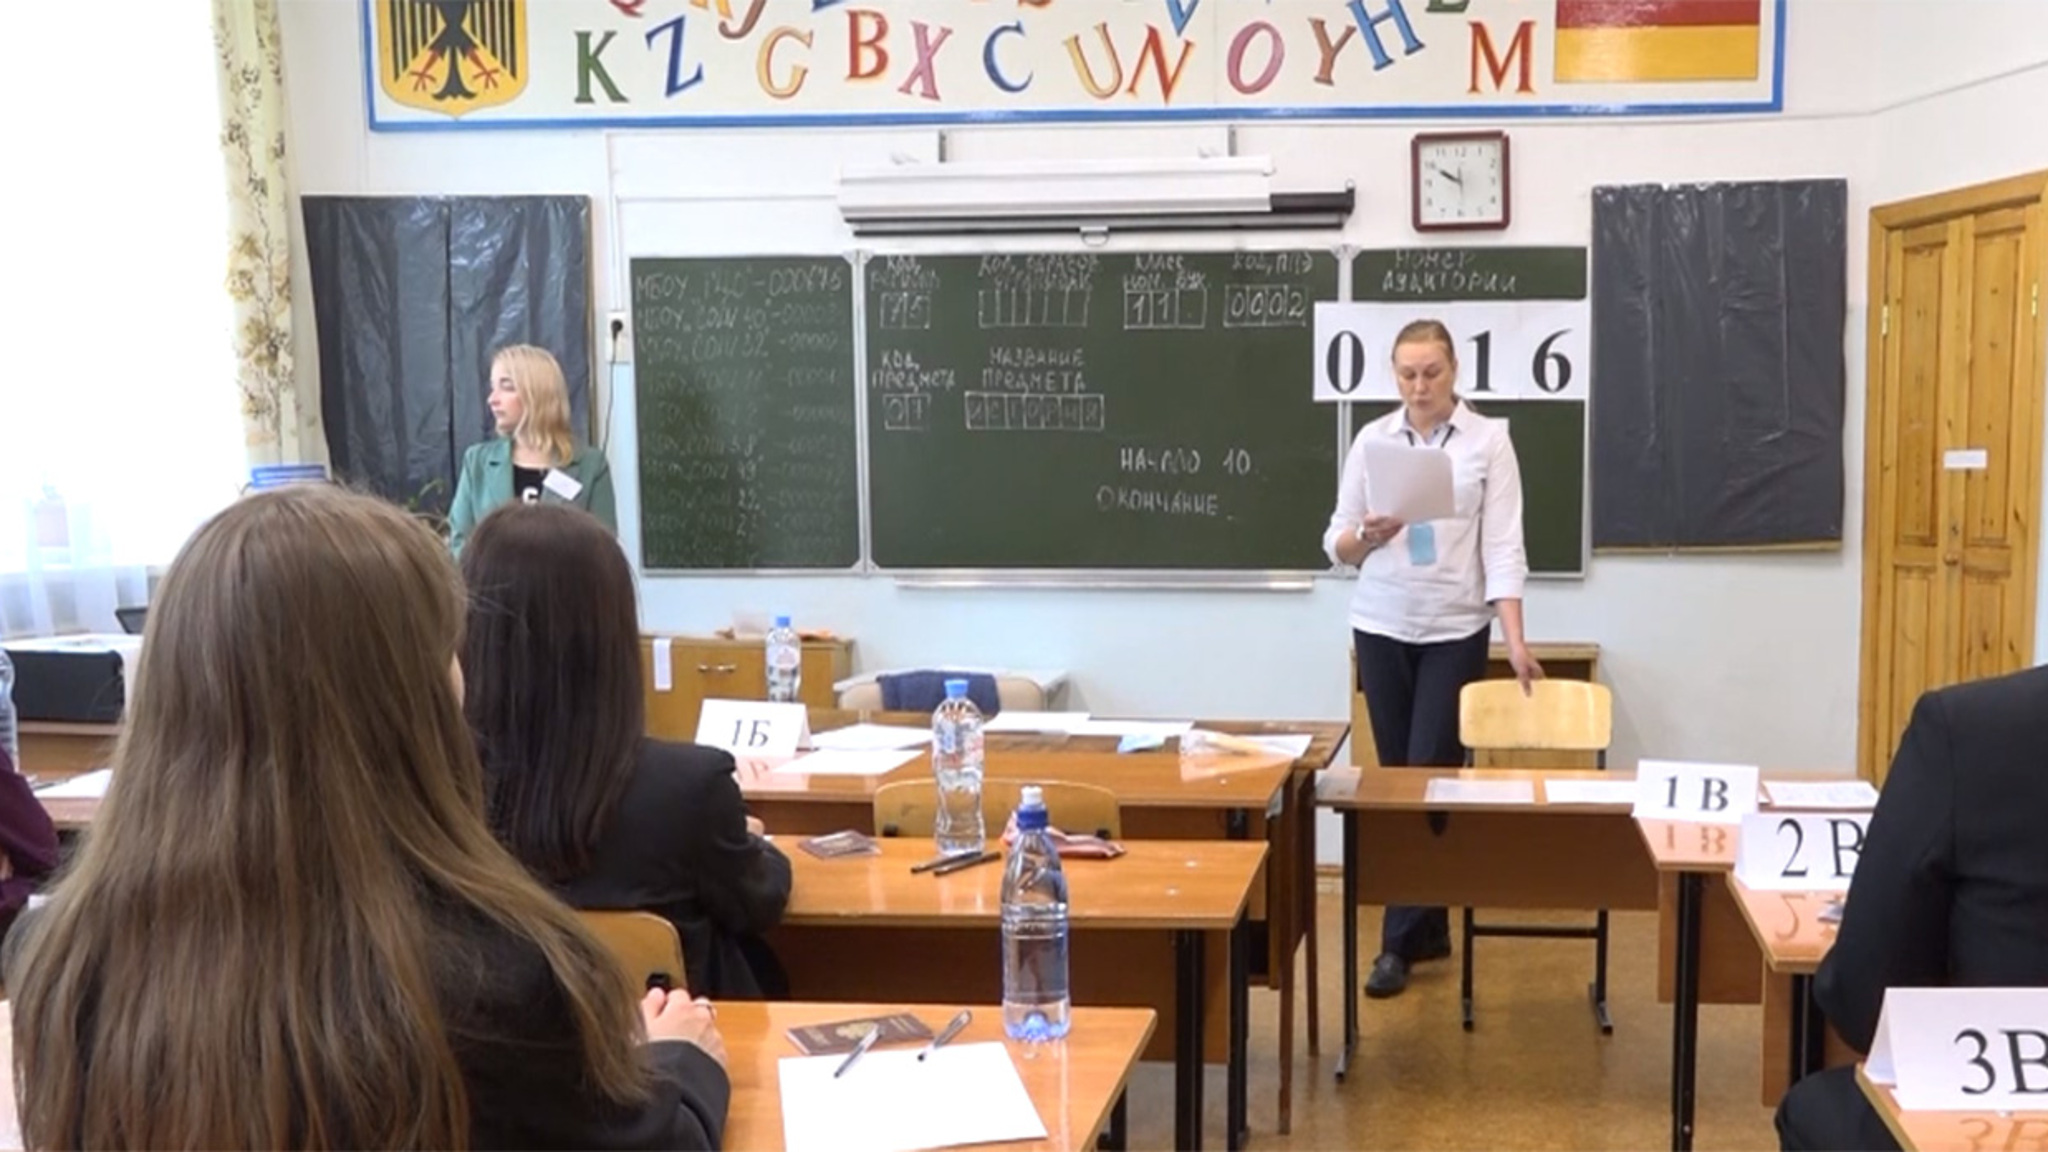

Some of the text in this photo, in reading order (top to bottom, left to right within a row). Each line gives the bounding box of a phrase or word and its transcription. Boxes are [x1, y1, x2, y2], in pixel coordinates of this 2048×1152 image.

[574, 30, 630, 103] K
[645, 15, 704, 98] Z
[756, 26, 815, 99] G
[845, 9, 889, 83] B
[898, 20, 953, 101] X
[982, 20, 1034, 94] C
[1063, 22, 1124, 100] U
[1127, 24, 1196, 105] N
[1227, 20, 1284, 95] O
[1308, 17, 1357, 87] Y
[1347, 0, 1426, 71] H
[1467, 20, 1536, 95] M
[1231, 291, 1305, 317] 0002
[1382, 270, 1516, 294] АУДИТОРИИ
[989, 347, 1085, 368] НАЗВАНИЕ
[1326, 330, 1573, 394] 016
[1096, 484, 1219, 516] ОКОНЧАНИЕ
[1665, 775, 1678, 808] 1
[1699, 777, 1730, 811] В
[1776, 818, 1809, 878] 2
